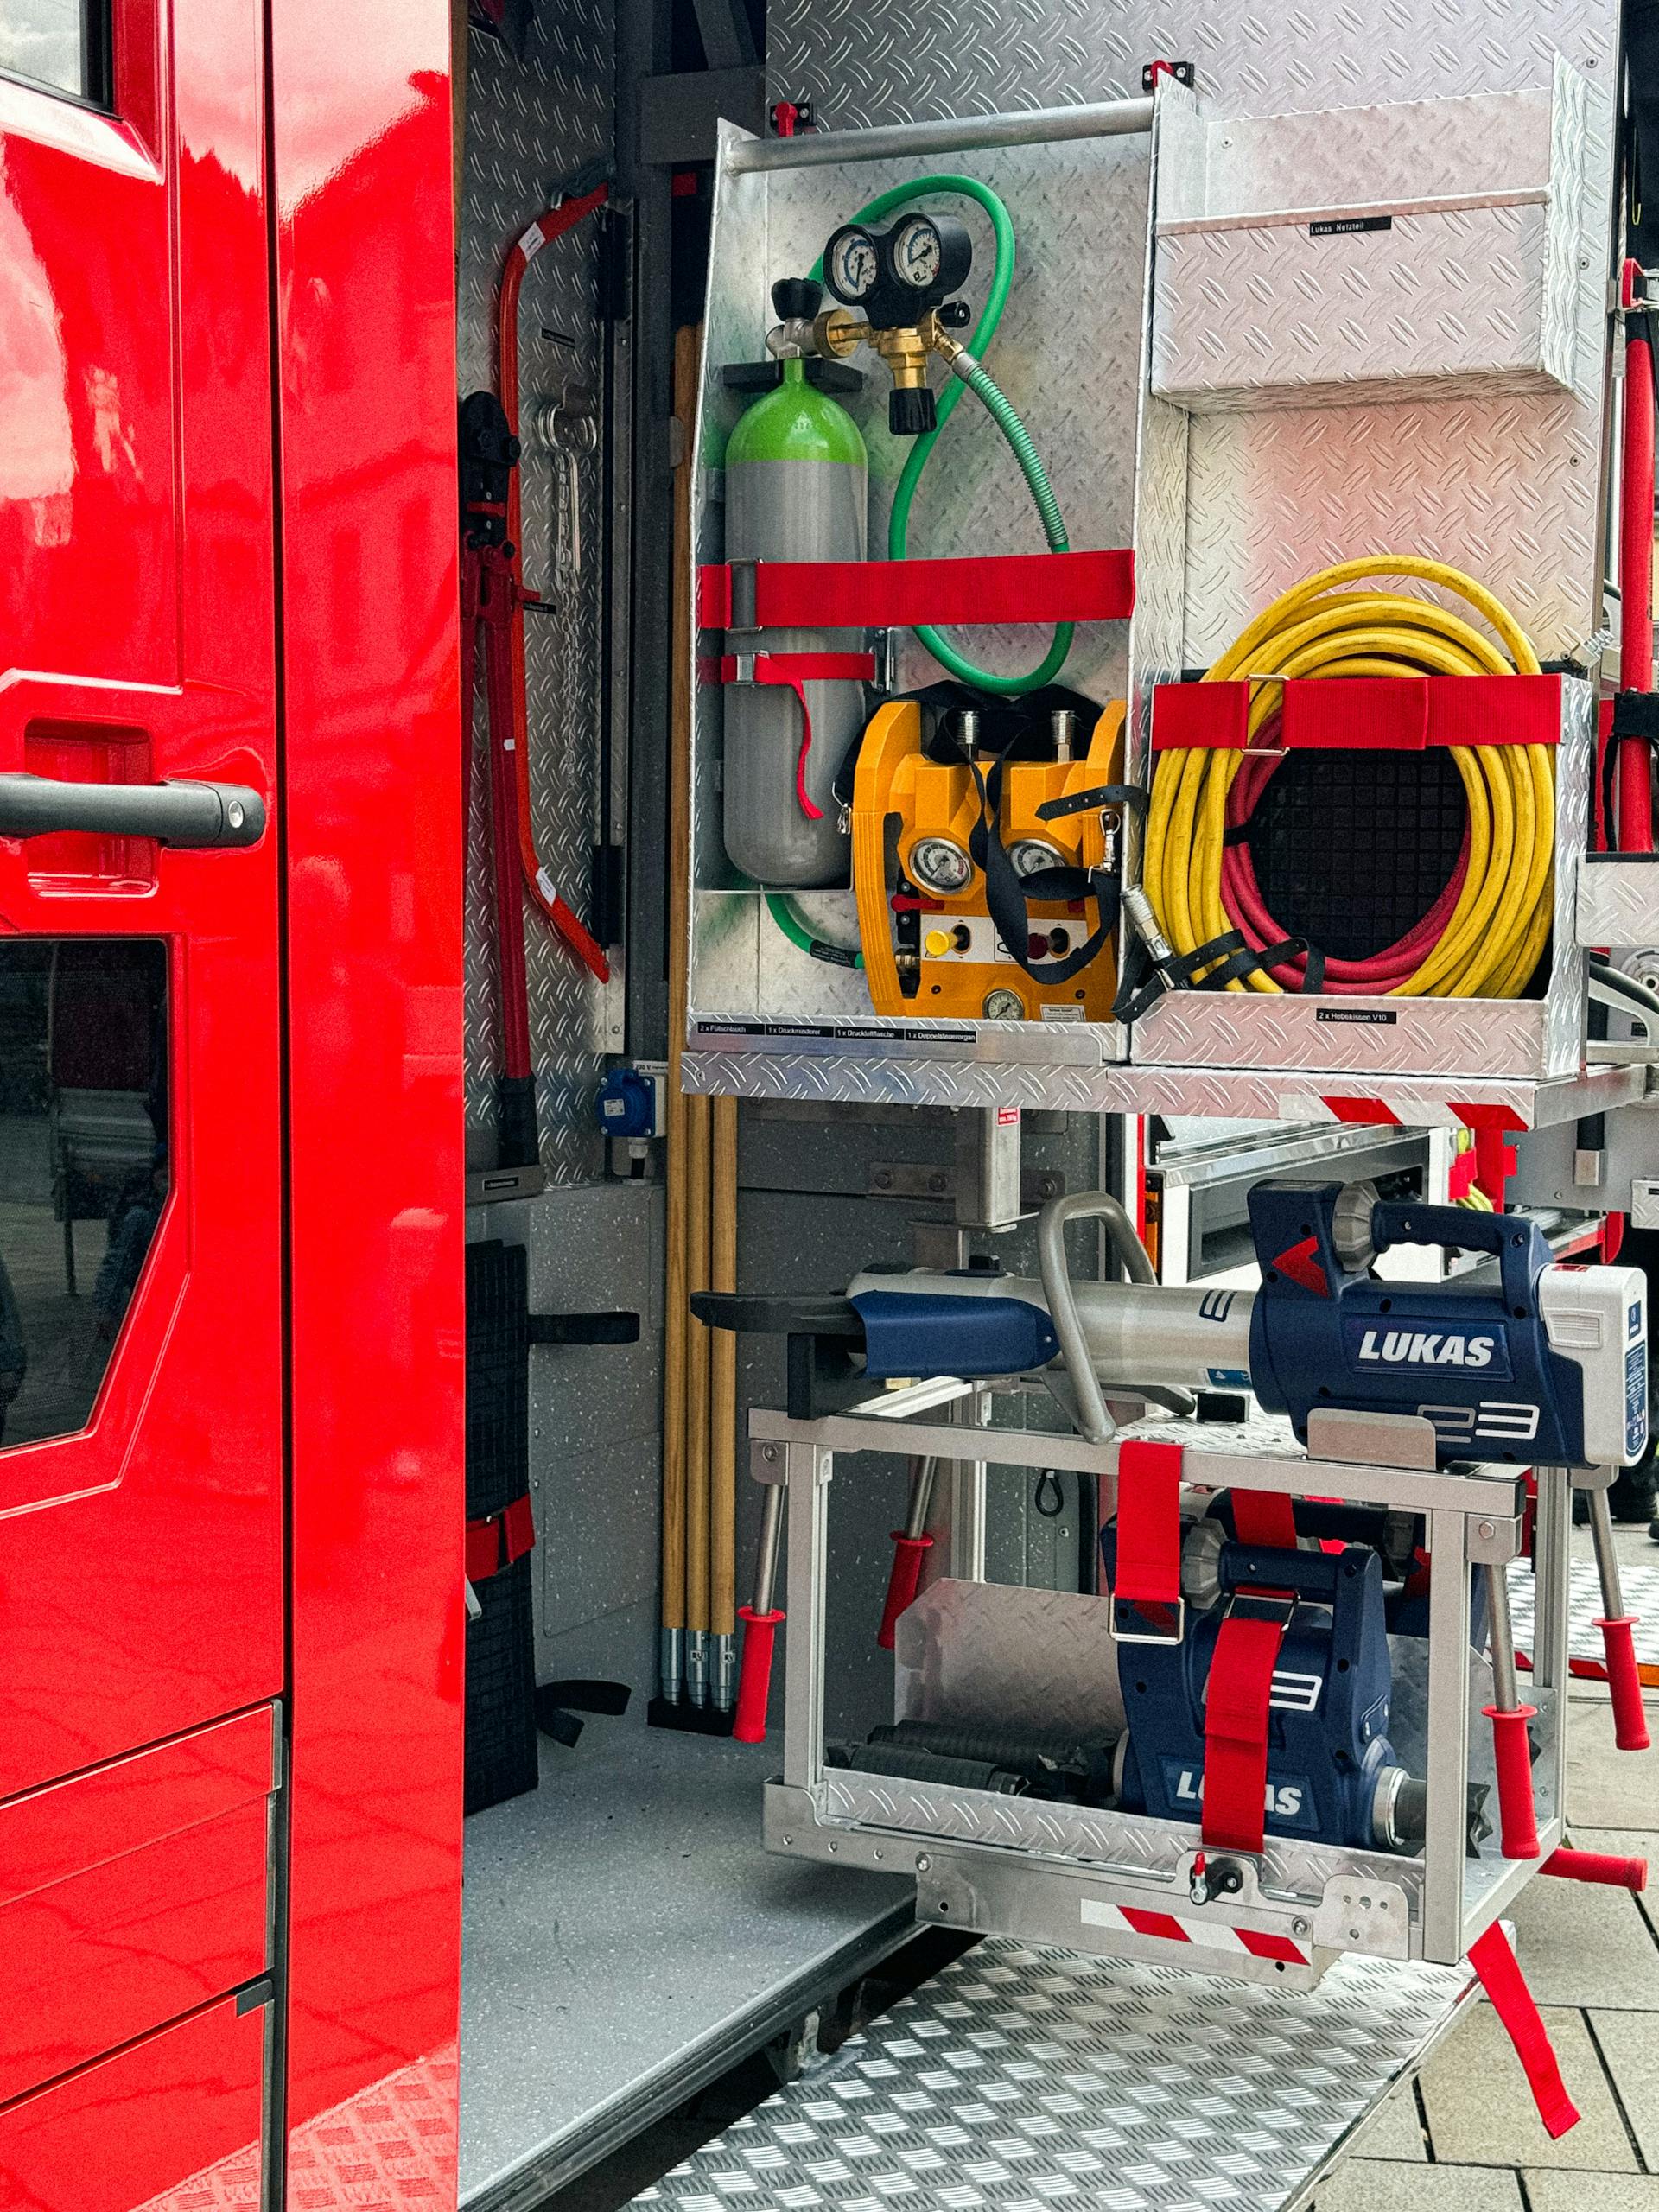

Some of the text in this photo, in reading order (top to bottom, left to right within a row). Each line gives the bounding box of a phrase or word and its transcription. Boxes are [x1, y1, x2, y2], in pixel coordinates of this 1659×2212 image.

[1311, 221, 1364, 233] Lukas Netzteil
[1331, 1012, 1371, 1021] Hebekissen
[1372, 1014, 1387, 1022] V10
[1358, 1331, 1495, 1367] LUKAS
